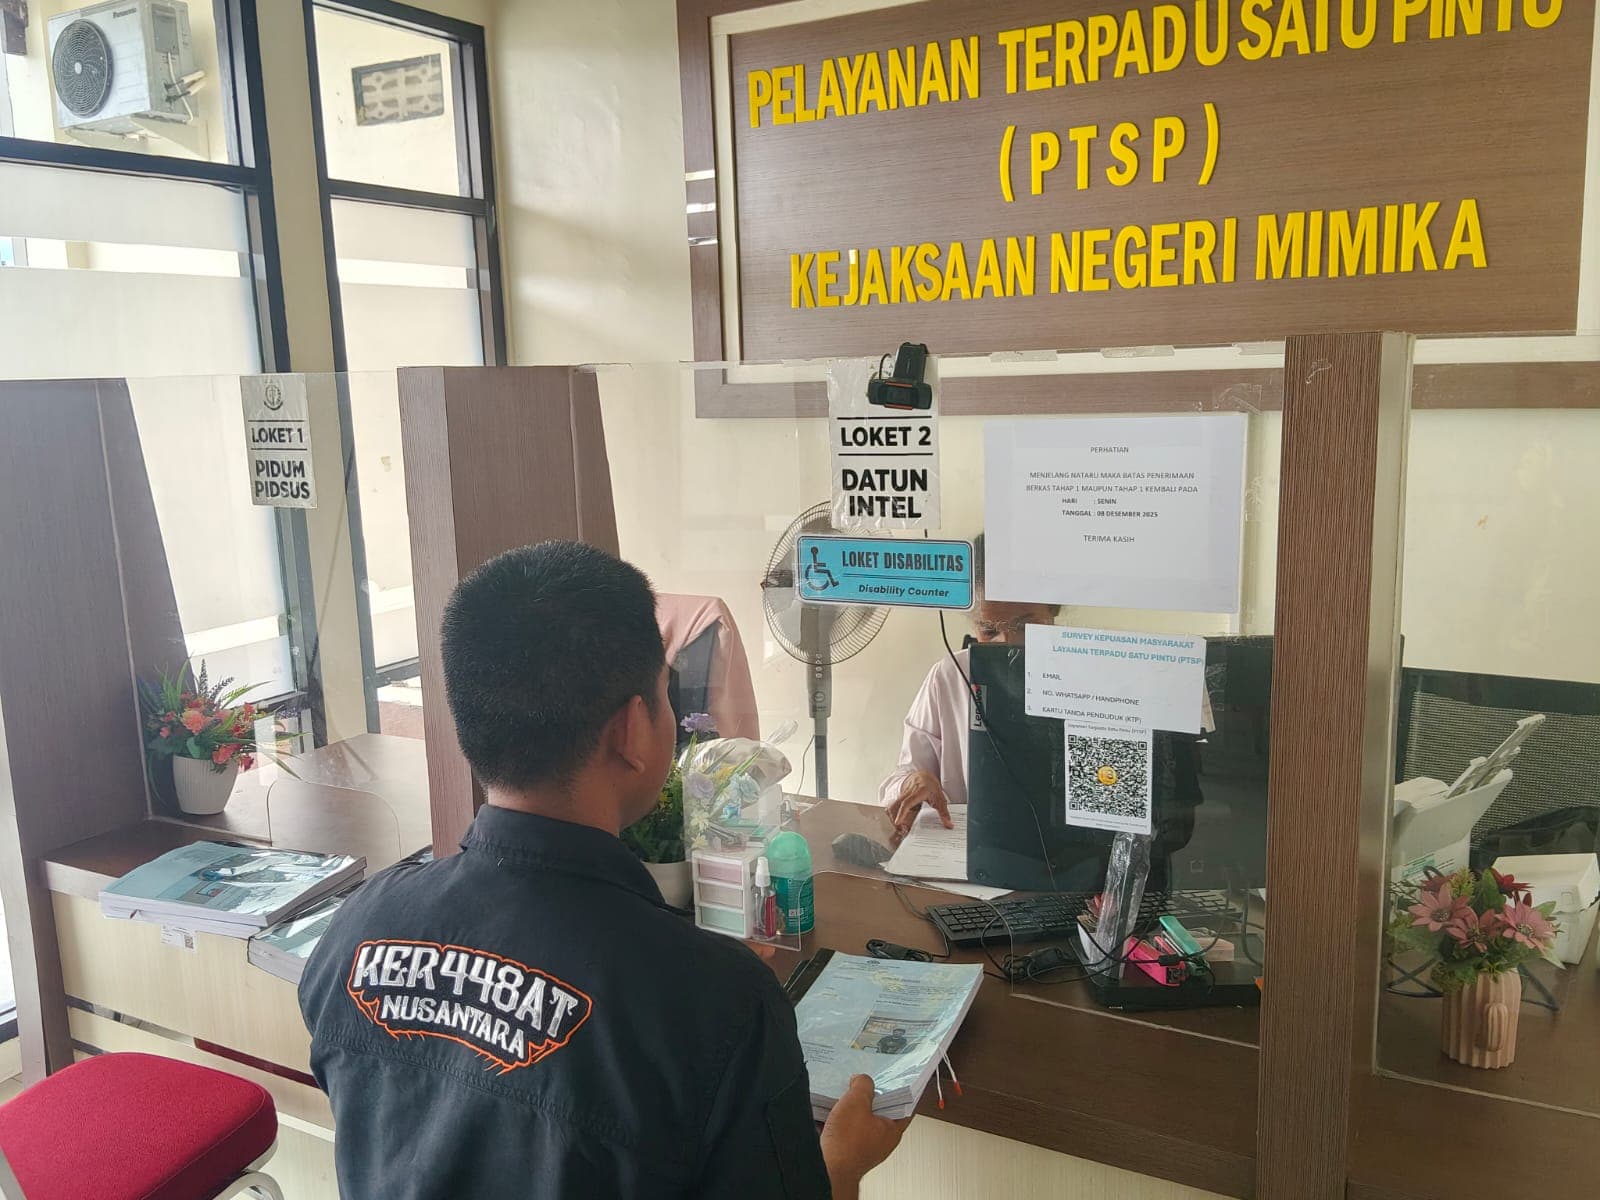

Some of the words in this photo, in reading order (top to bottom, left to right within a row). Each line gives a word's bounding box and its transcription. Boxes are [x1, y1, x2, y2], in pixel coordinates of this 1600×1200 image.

[748, 35, 980, 128] PELAYANAN
[998, 0, 1229, 94] TERPADU
[790, 235, 1037, 308] KEJAKSAAN
[1050, 216, 1237, 294] NEGERI
[1256, 198, 1488, 281] MIMIKA
[251, 427, 293, 443] LOKET
[297, 427, 304, 443] 1
[840, 426, 913, 447] LOKET
[918, 426, 932, 446] 2
[255, 460, 306, 478] PIDUM
[841, 468, 929, 492] DATUN
[254, 480, 311, 499] PIDSUS
[849, 495, 922, 518] INTEL
[842, 550, 880, 569] LOKET
[883, 551, 964, 572] DISABILITAS
[858, 584, 905, 597] Disability
[908, 586, 950, 598] Counter
[1062, 631, 1093, 641] SURVEY
[1094, 634, 1138, 645] KEPUASAN
[1139, 637, 1195, 648] MASYARAKAT
[1052, 645, 1088, 655] LAYANAN
[1090, 648, 1128, 658] TERPADU
[1128, 651, 1149, 661] SATU
[1151, 653, 1176, 663] PINTU
[1042, 672, 1062, 681] EMAIL
[1055, 691, 1090, 700] WHATSAPP
[1095, 695, 1140, 705] HANDPHONE
[1042, 706, 1063, 714] KARTU
[1064, 709, 1085, 717] TANDA
[1086, 712, 1123, 721] PENDUDUK
[381, 995, 526, 1060] NUSANTARA
